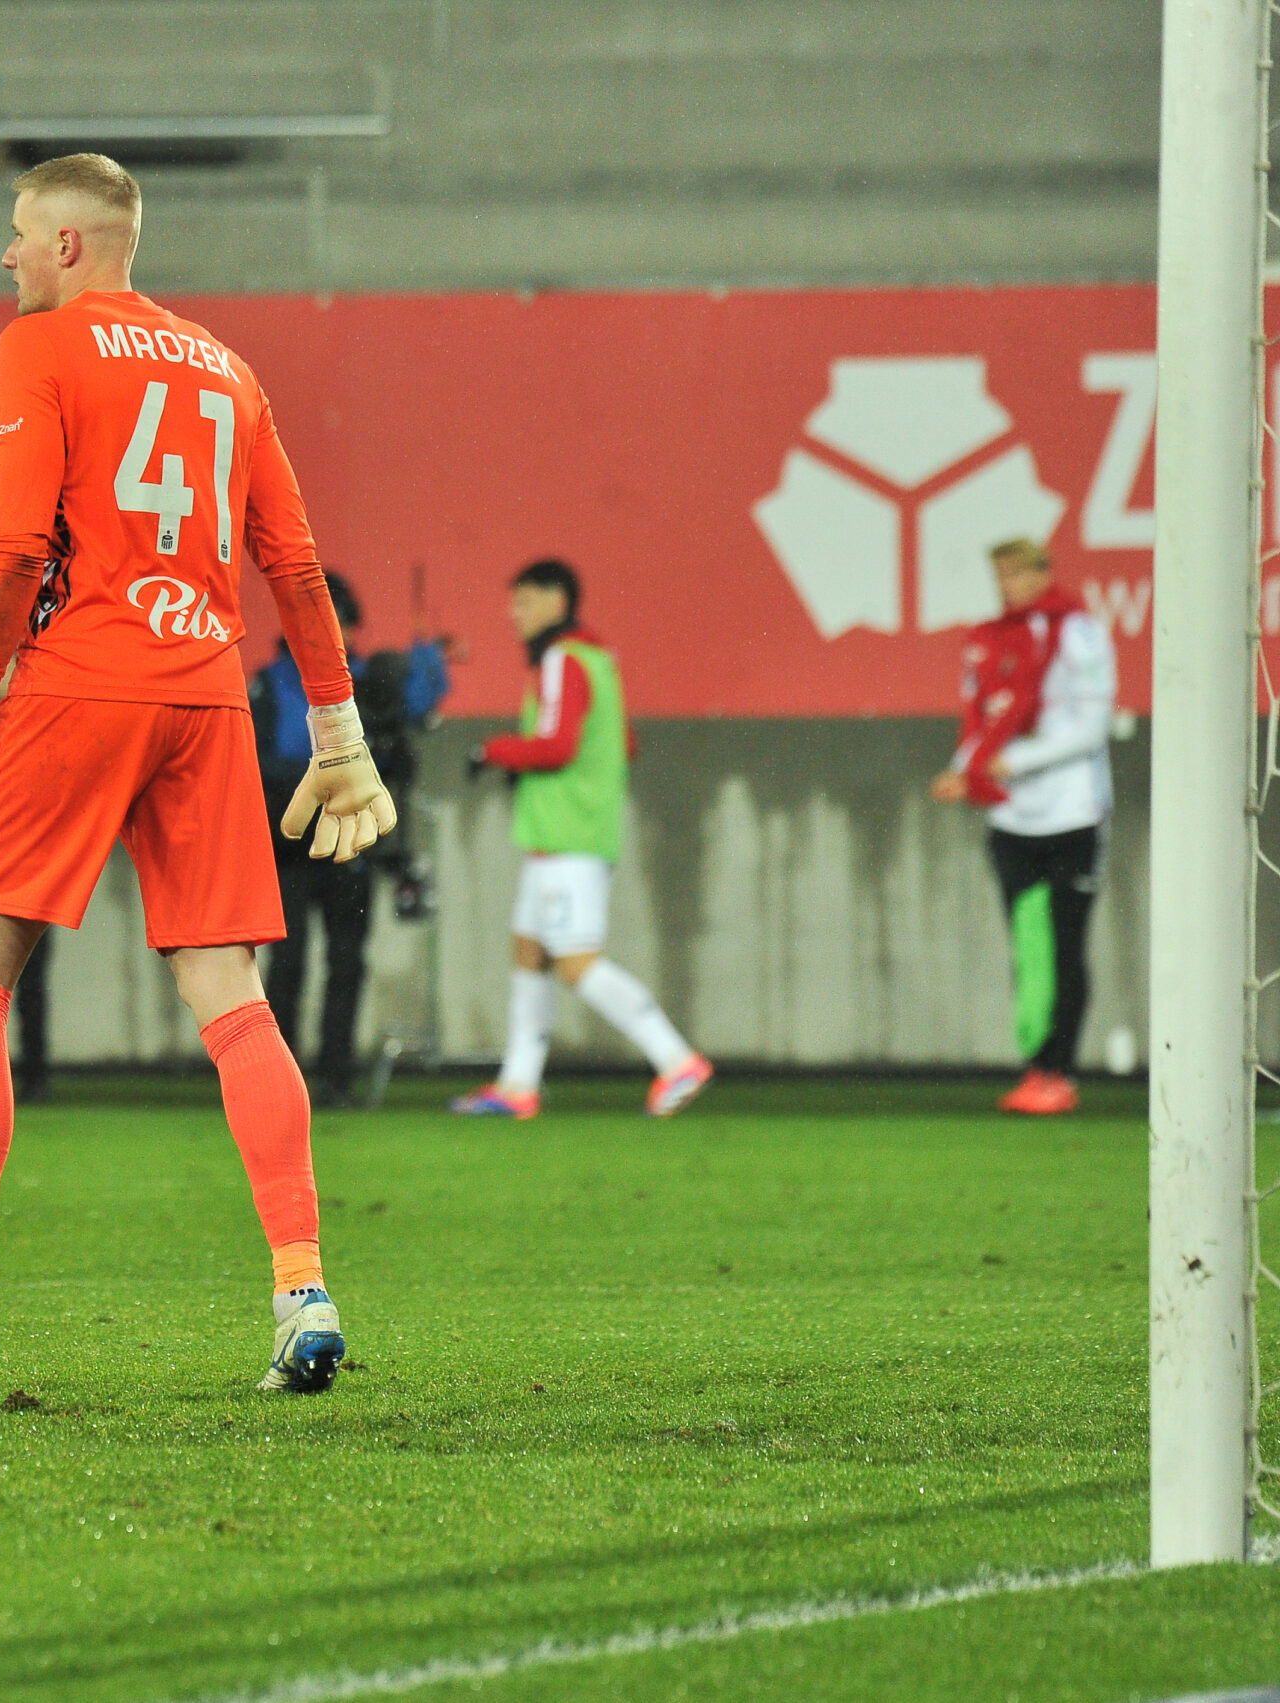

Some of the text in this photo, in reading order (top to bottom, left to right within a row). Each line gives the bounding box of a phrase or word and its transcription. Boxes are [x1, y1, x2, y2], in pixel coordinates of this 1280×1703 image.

[90, 323, 241, 383] MROZEK
[113, 380, 235, 565] 41
[126, 575, 230, 642] Pils
